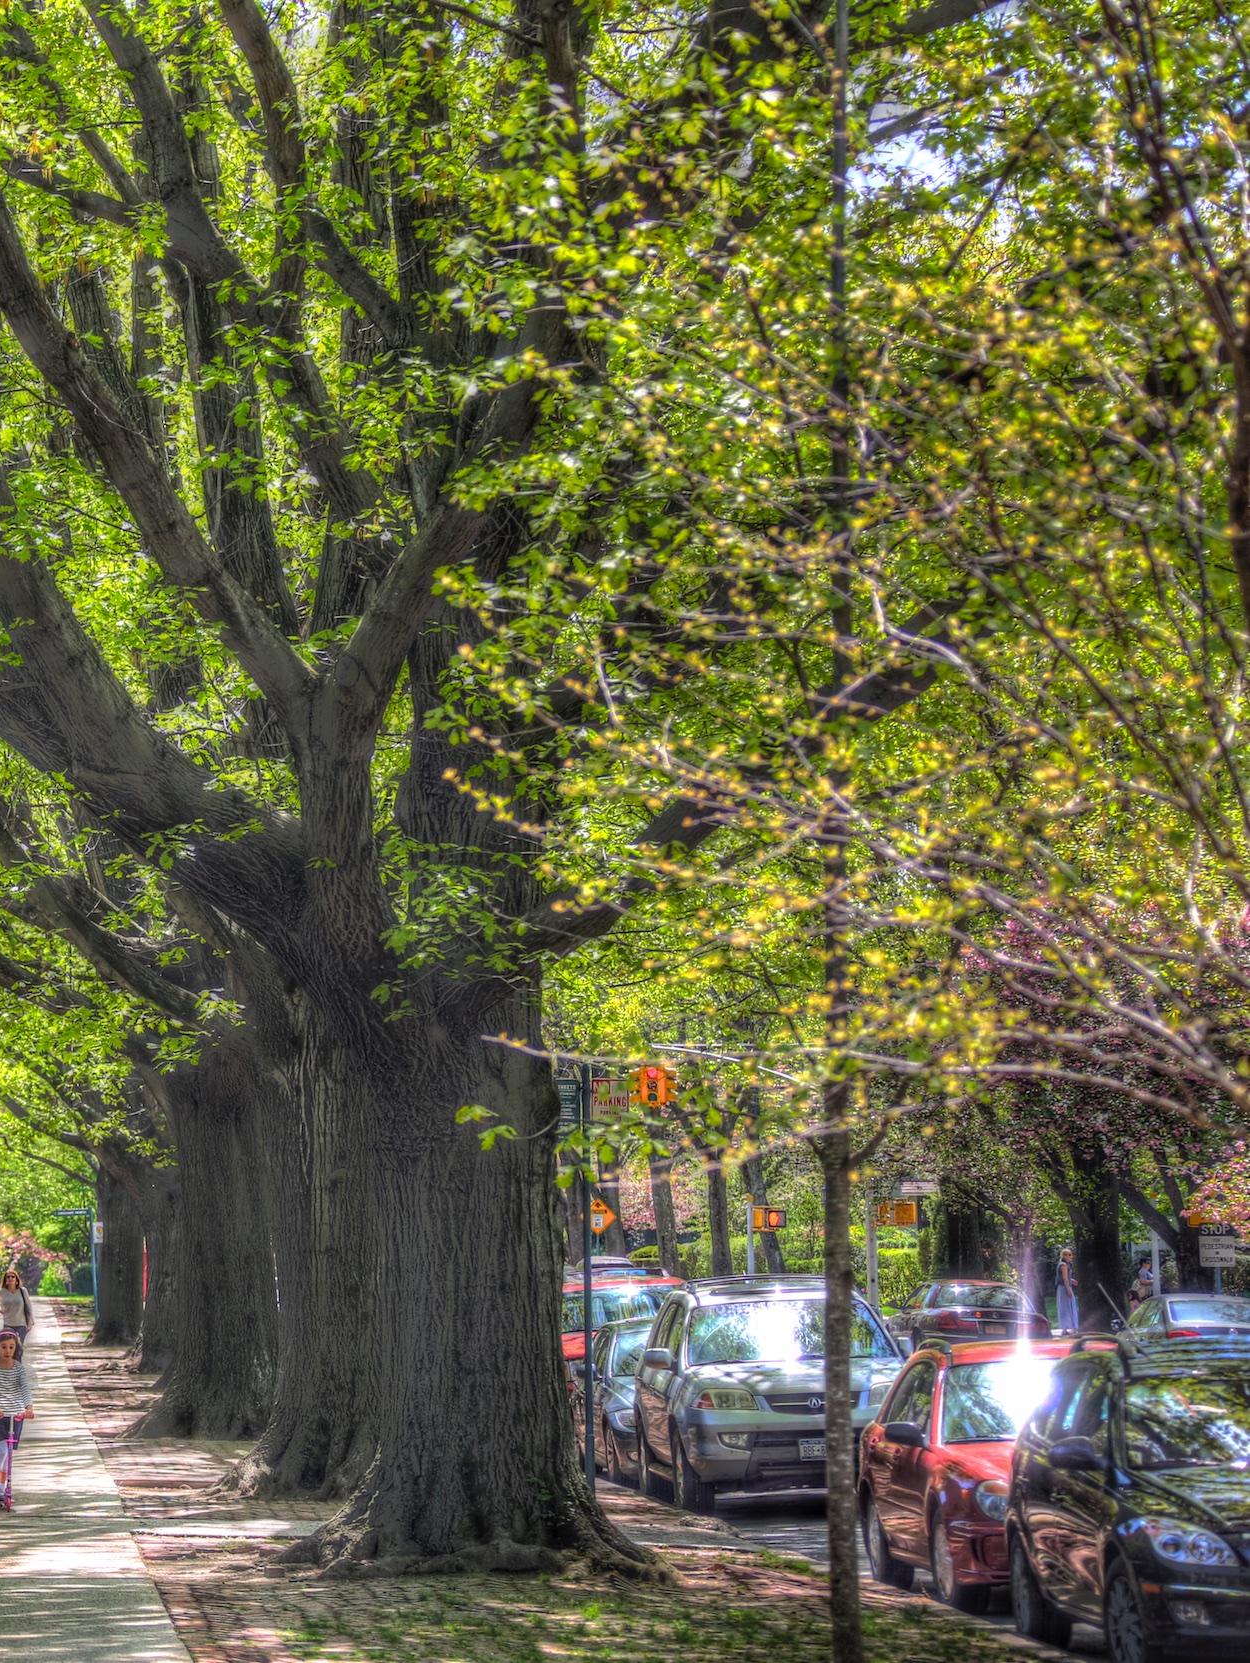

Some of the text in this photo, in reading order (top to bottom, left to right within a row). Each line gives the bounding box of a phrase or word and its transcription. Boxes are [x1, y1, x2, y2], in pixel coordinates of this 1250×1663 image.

[594, 1096, 627, 1107] PARKING
[1201, 1224, 1230, 1235] STOP
[803, 1445, 826, 1456] BBF-8
